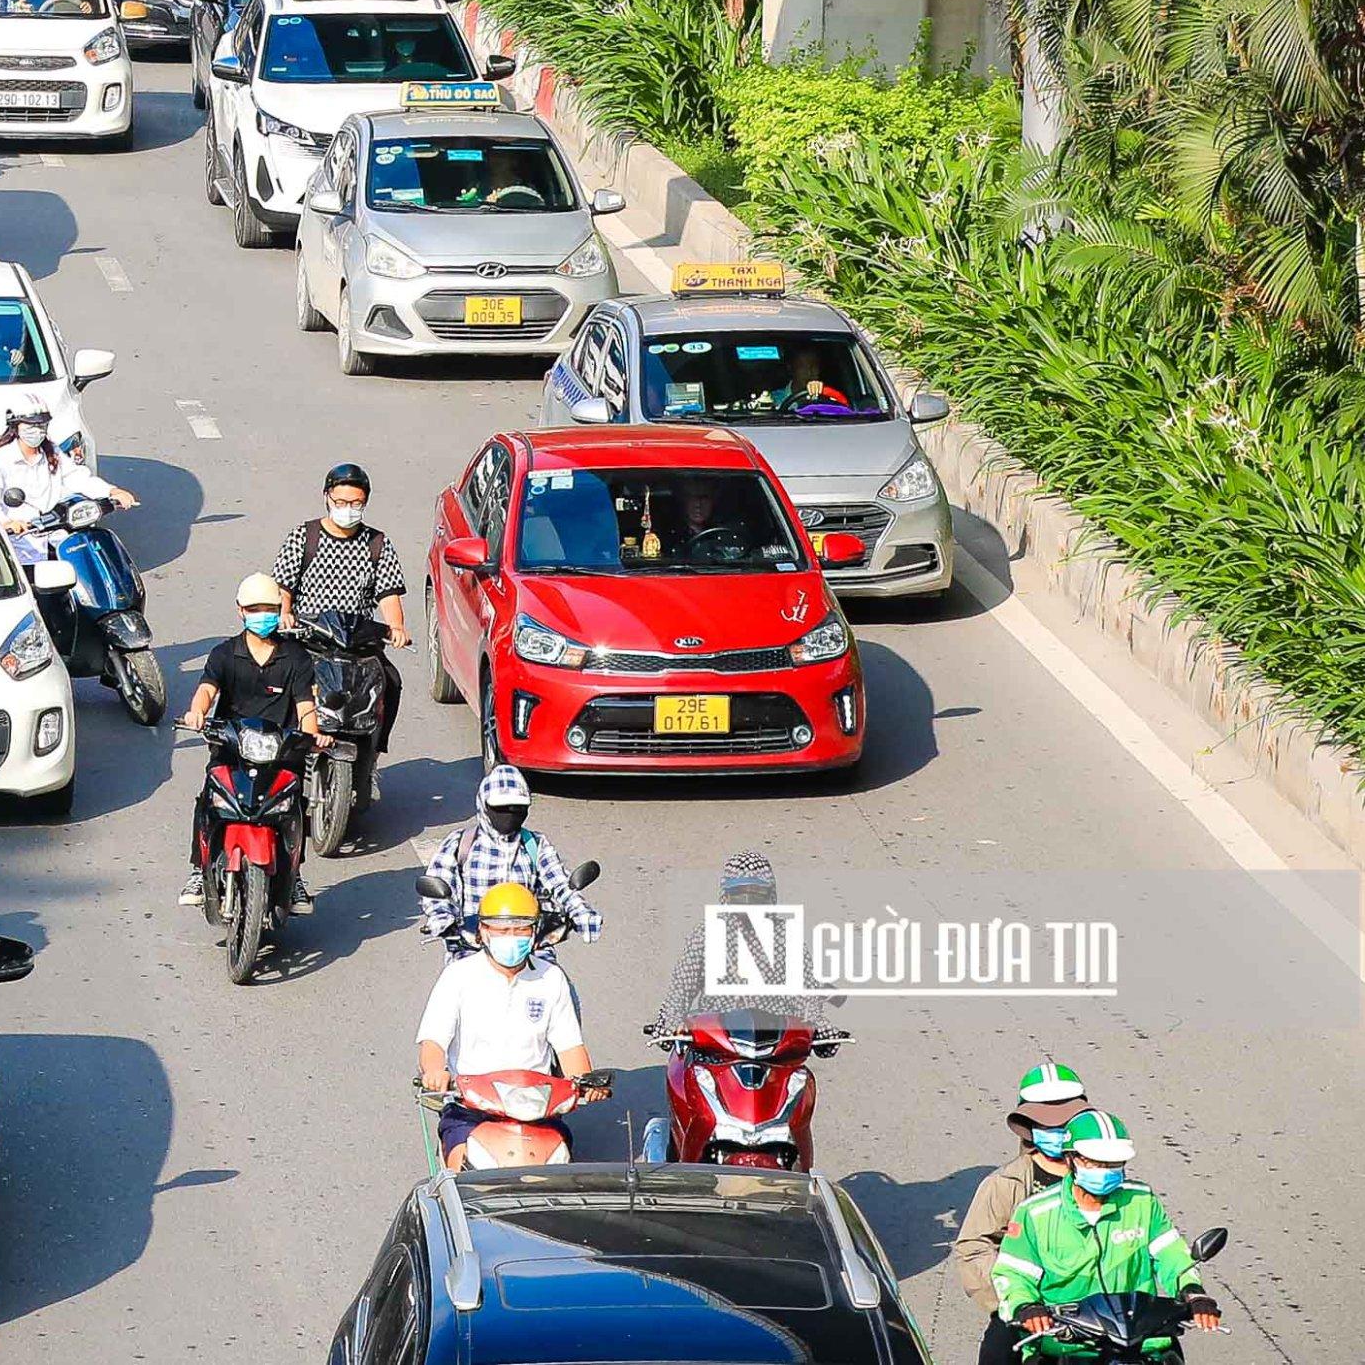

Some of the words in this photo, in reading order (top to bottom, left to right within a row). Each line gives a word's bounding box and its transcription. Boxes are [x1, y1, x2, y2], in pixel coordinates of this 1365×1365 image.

[730, 266, 757, 274] TAXI
[711, 278, 752, 287] THANH
[756, 278, 781, 287] NGA
[481, 298, 504, 310] 30E
[677, 699, 707, 713] 29E
[664, 716, 720, 731] 017.61
